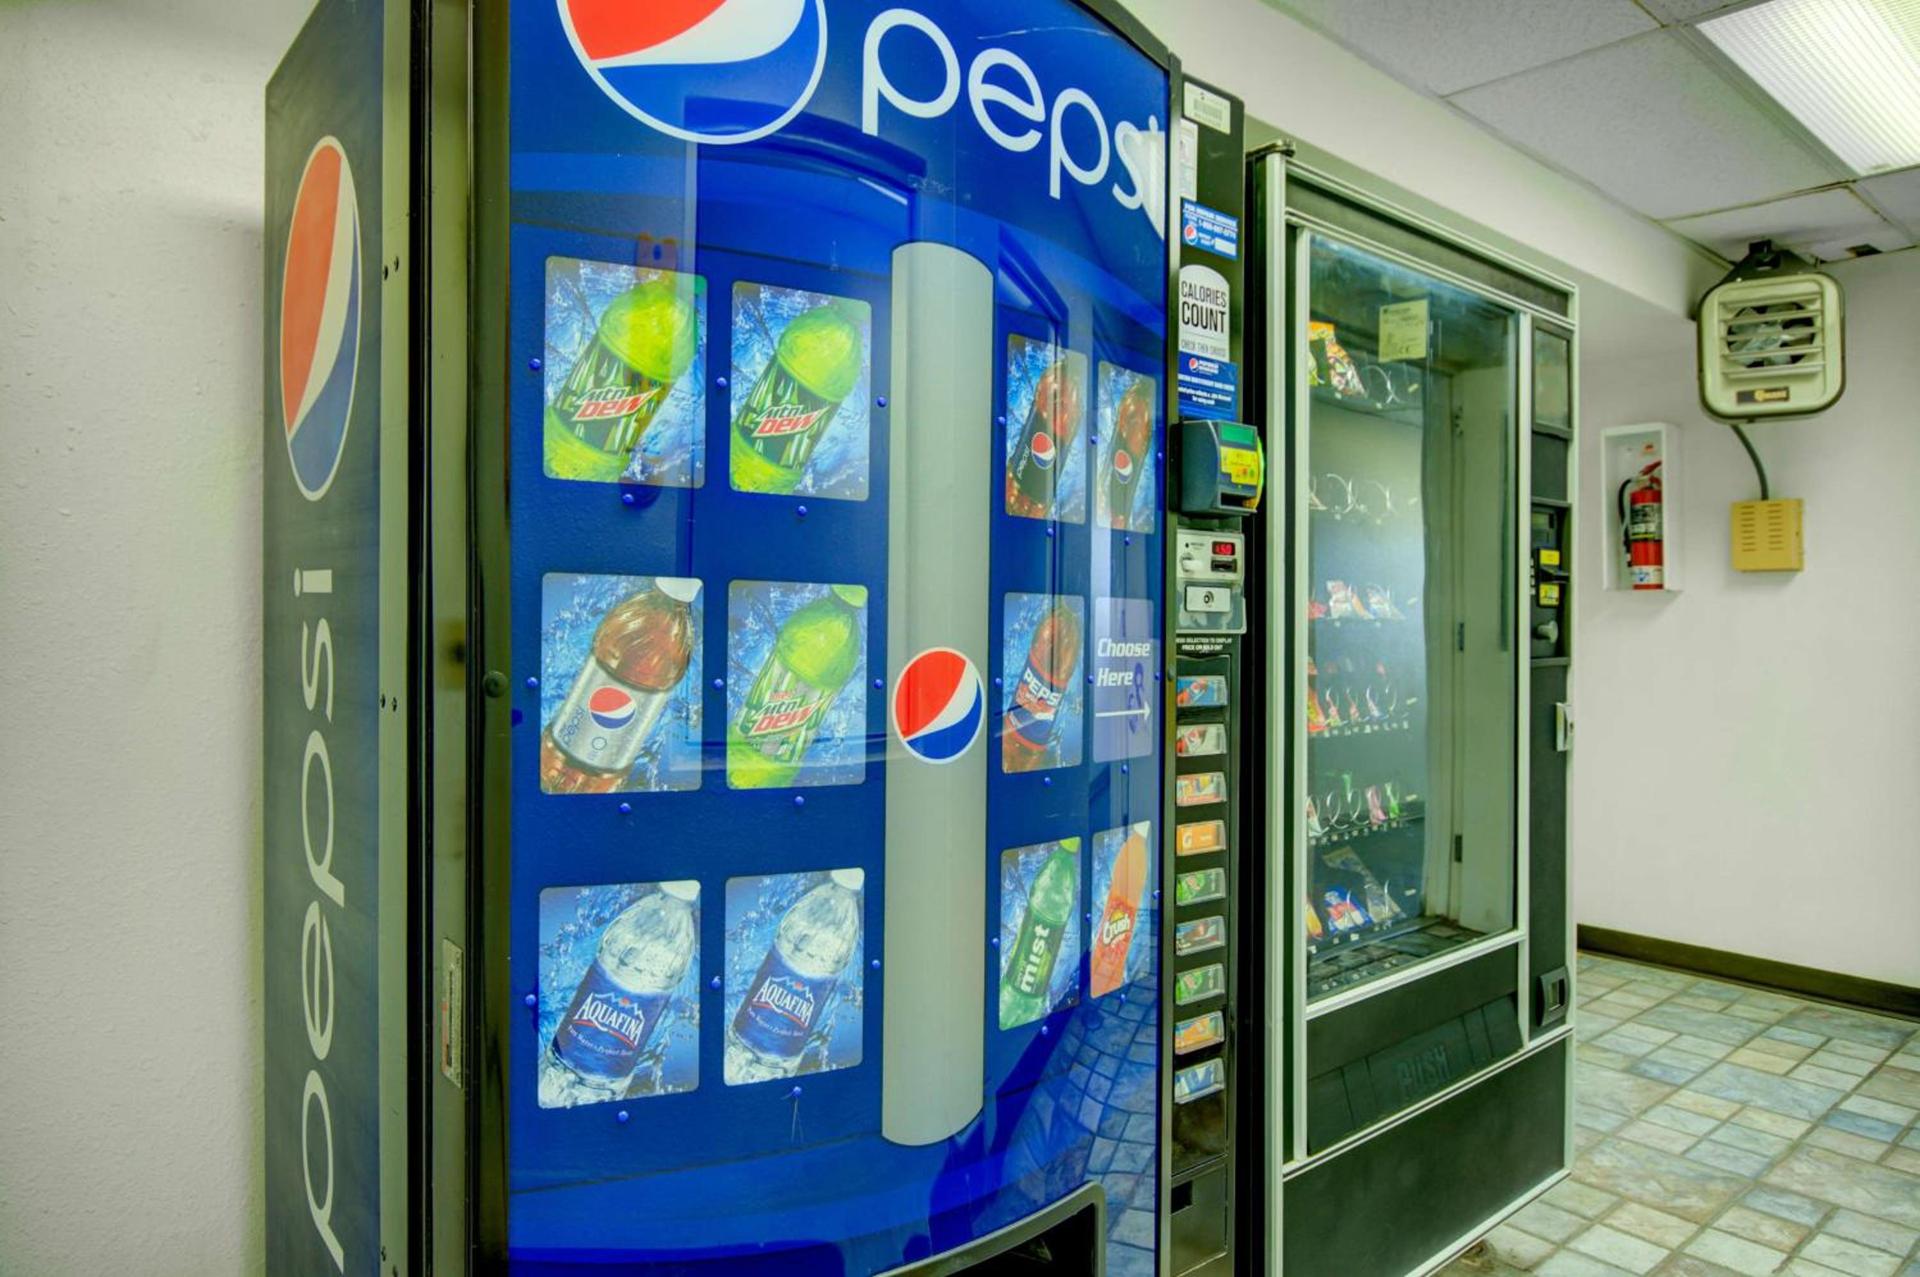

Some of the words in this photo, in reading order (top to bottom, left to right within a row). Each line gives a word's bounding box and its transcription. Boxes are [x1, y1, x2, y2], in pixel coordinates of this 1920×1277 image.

[862, 8, 1160, 222] pepsi
[1181, 280, 1227, 308] CALORIES
[1181, 301, 1226, 334] COUNT
[1097, 637, 1151, 658] Choose
[1096, 668, 1134, 687] Here
[294, 568, 345, 1275] pepsi
[1102, 913, 1131, 945] Crush
[1020, 924, 1050, 993] mist
[573, 991, 645, 1046] AQUAFINA
[752, 975, 815, 1027] AQUAFINA
